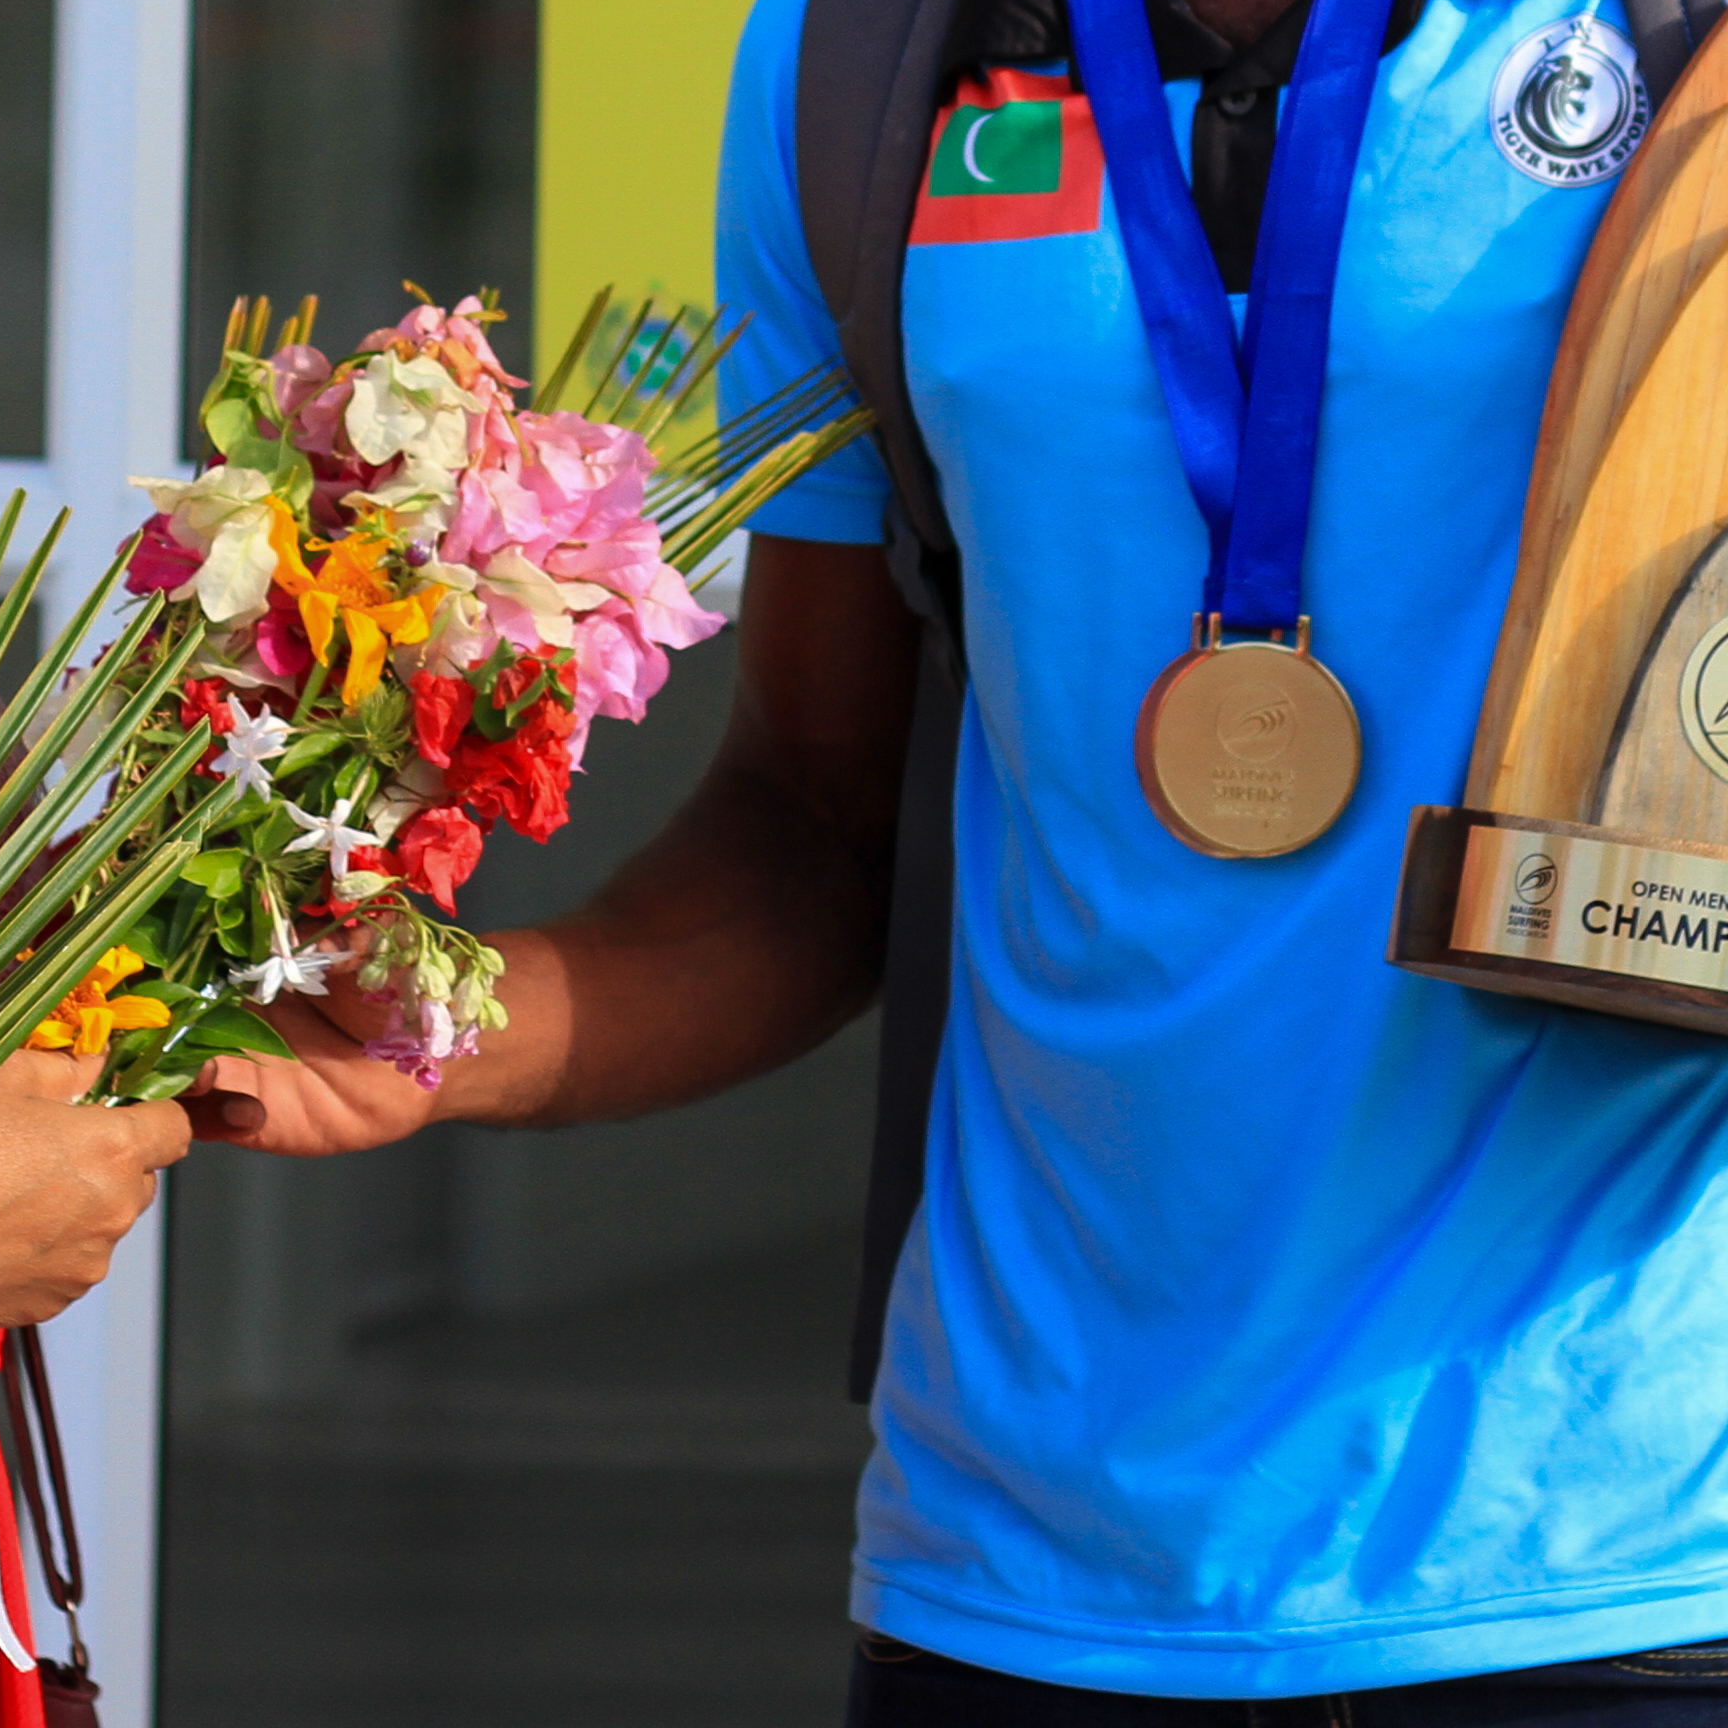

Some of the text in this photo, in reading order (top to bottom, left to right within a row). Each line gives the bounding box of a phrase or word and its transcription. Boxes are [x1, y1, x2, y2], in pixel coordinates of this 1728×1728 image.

[1497, 111, 1542, 169] TIGER
[1548, 158, 1607, 180] WAVE
[1632, 880, 1684, 904] OPEN
[1507, 915, 1550, 931] SURFING
